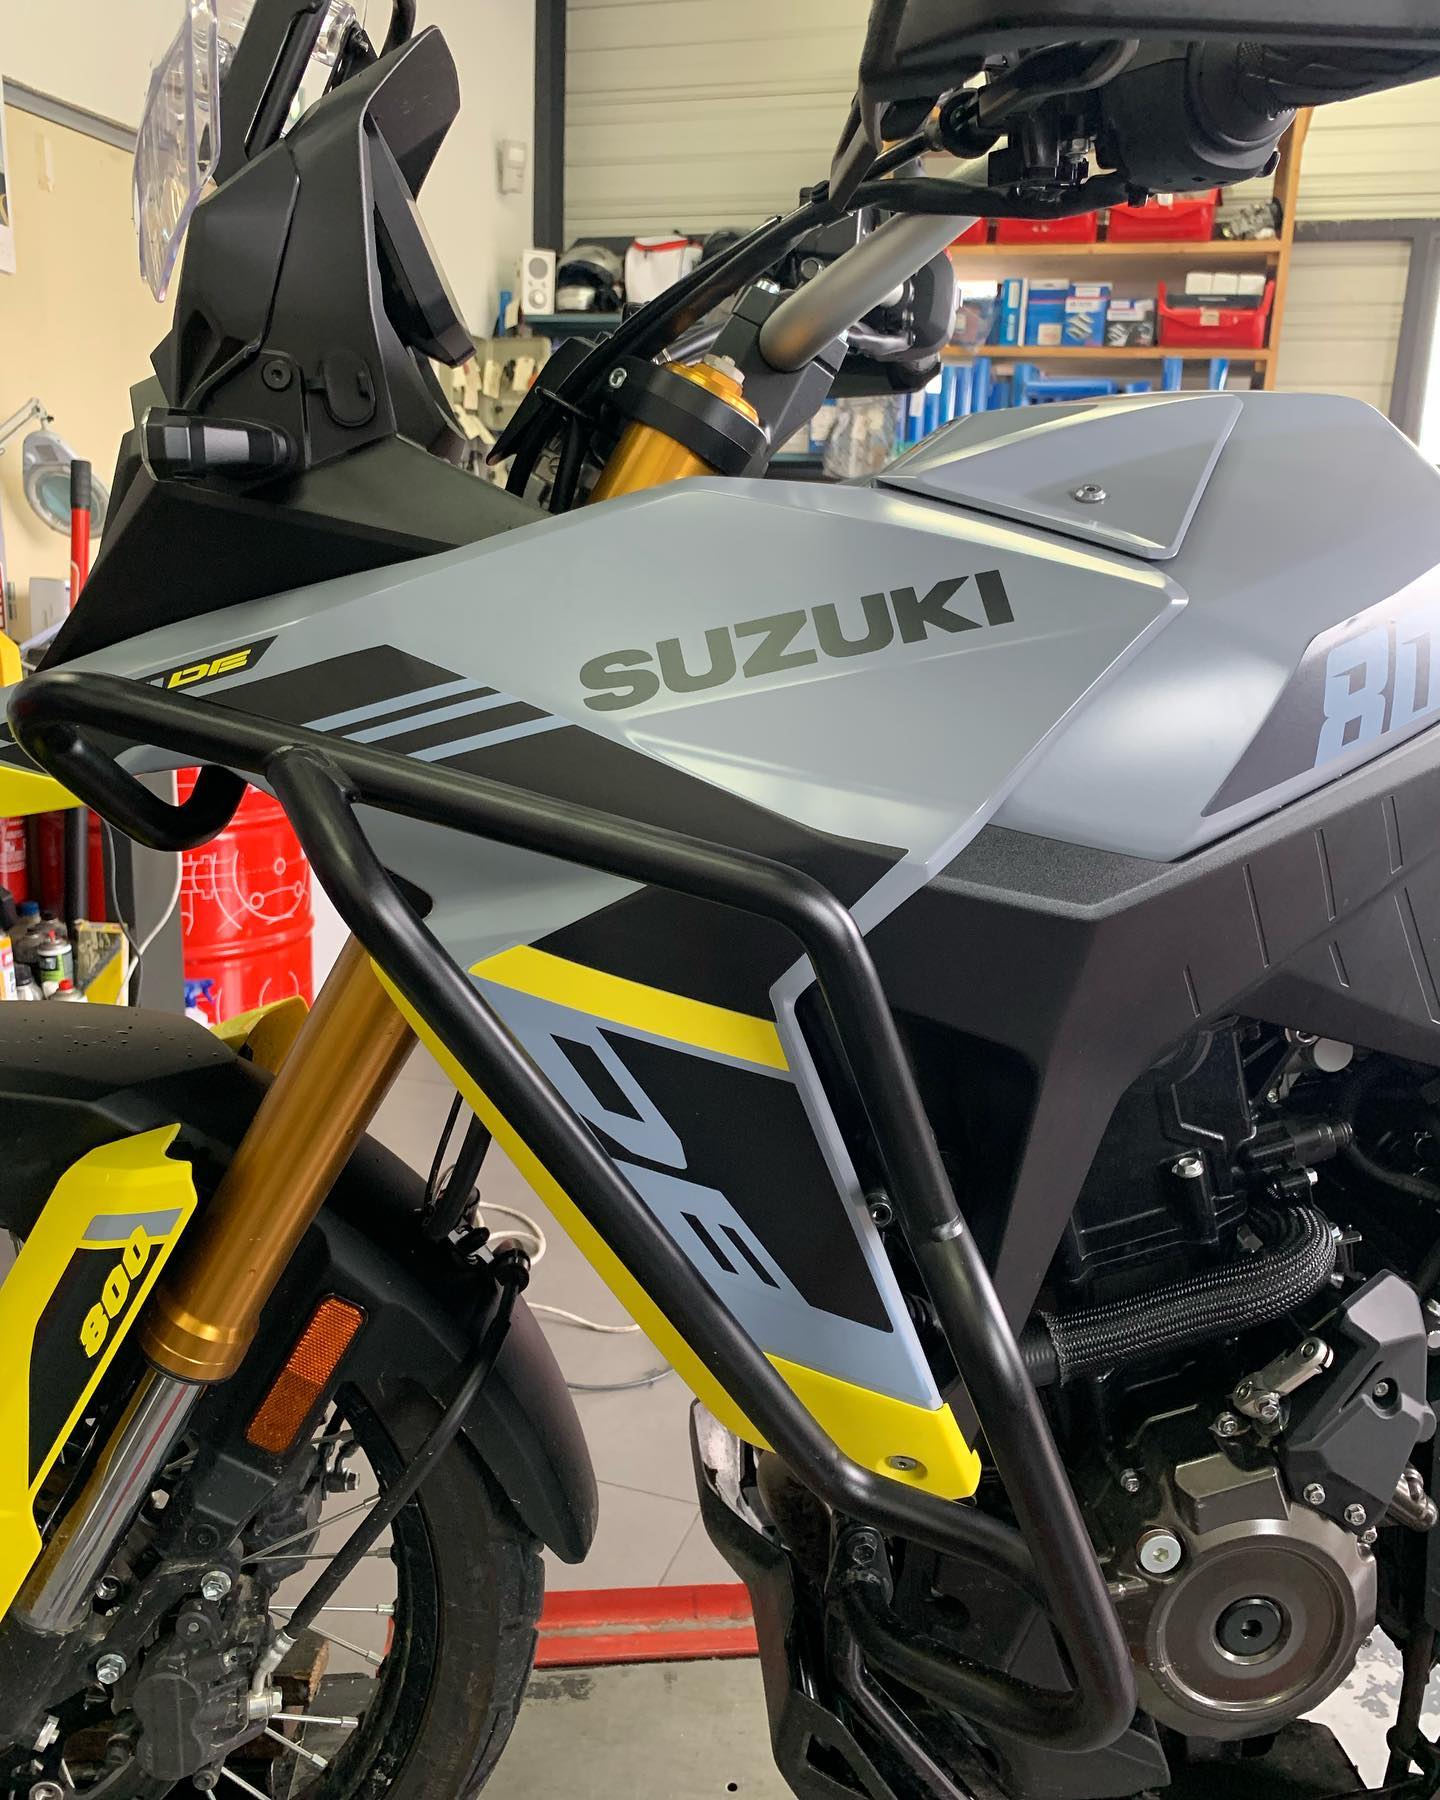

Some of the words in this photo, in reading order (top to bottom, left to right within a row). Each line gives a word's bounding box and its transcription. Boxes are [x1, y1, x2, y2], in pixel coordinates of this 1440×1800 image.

[167, 649, 252, 689] DE
[579, 569, 1015, 712] SUZUKI
[80, 1224, 151, 1359] 800
